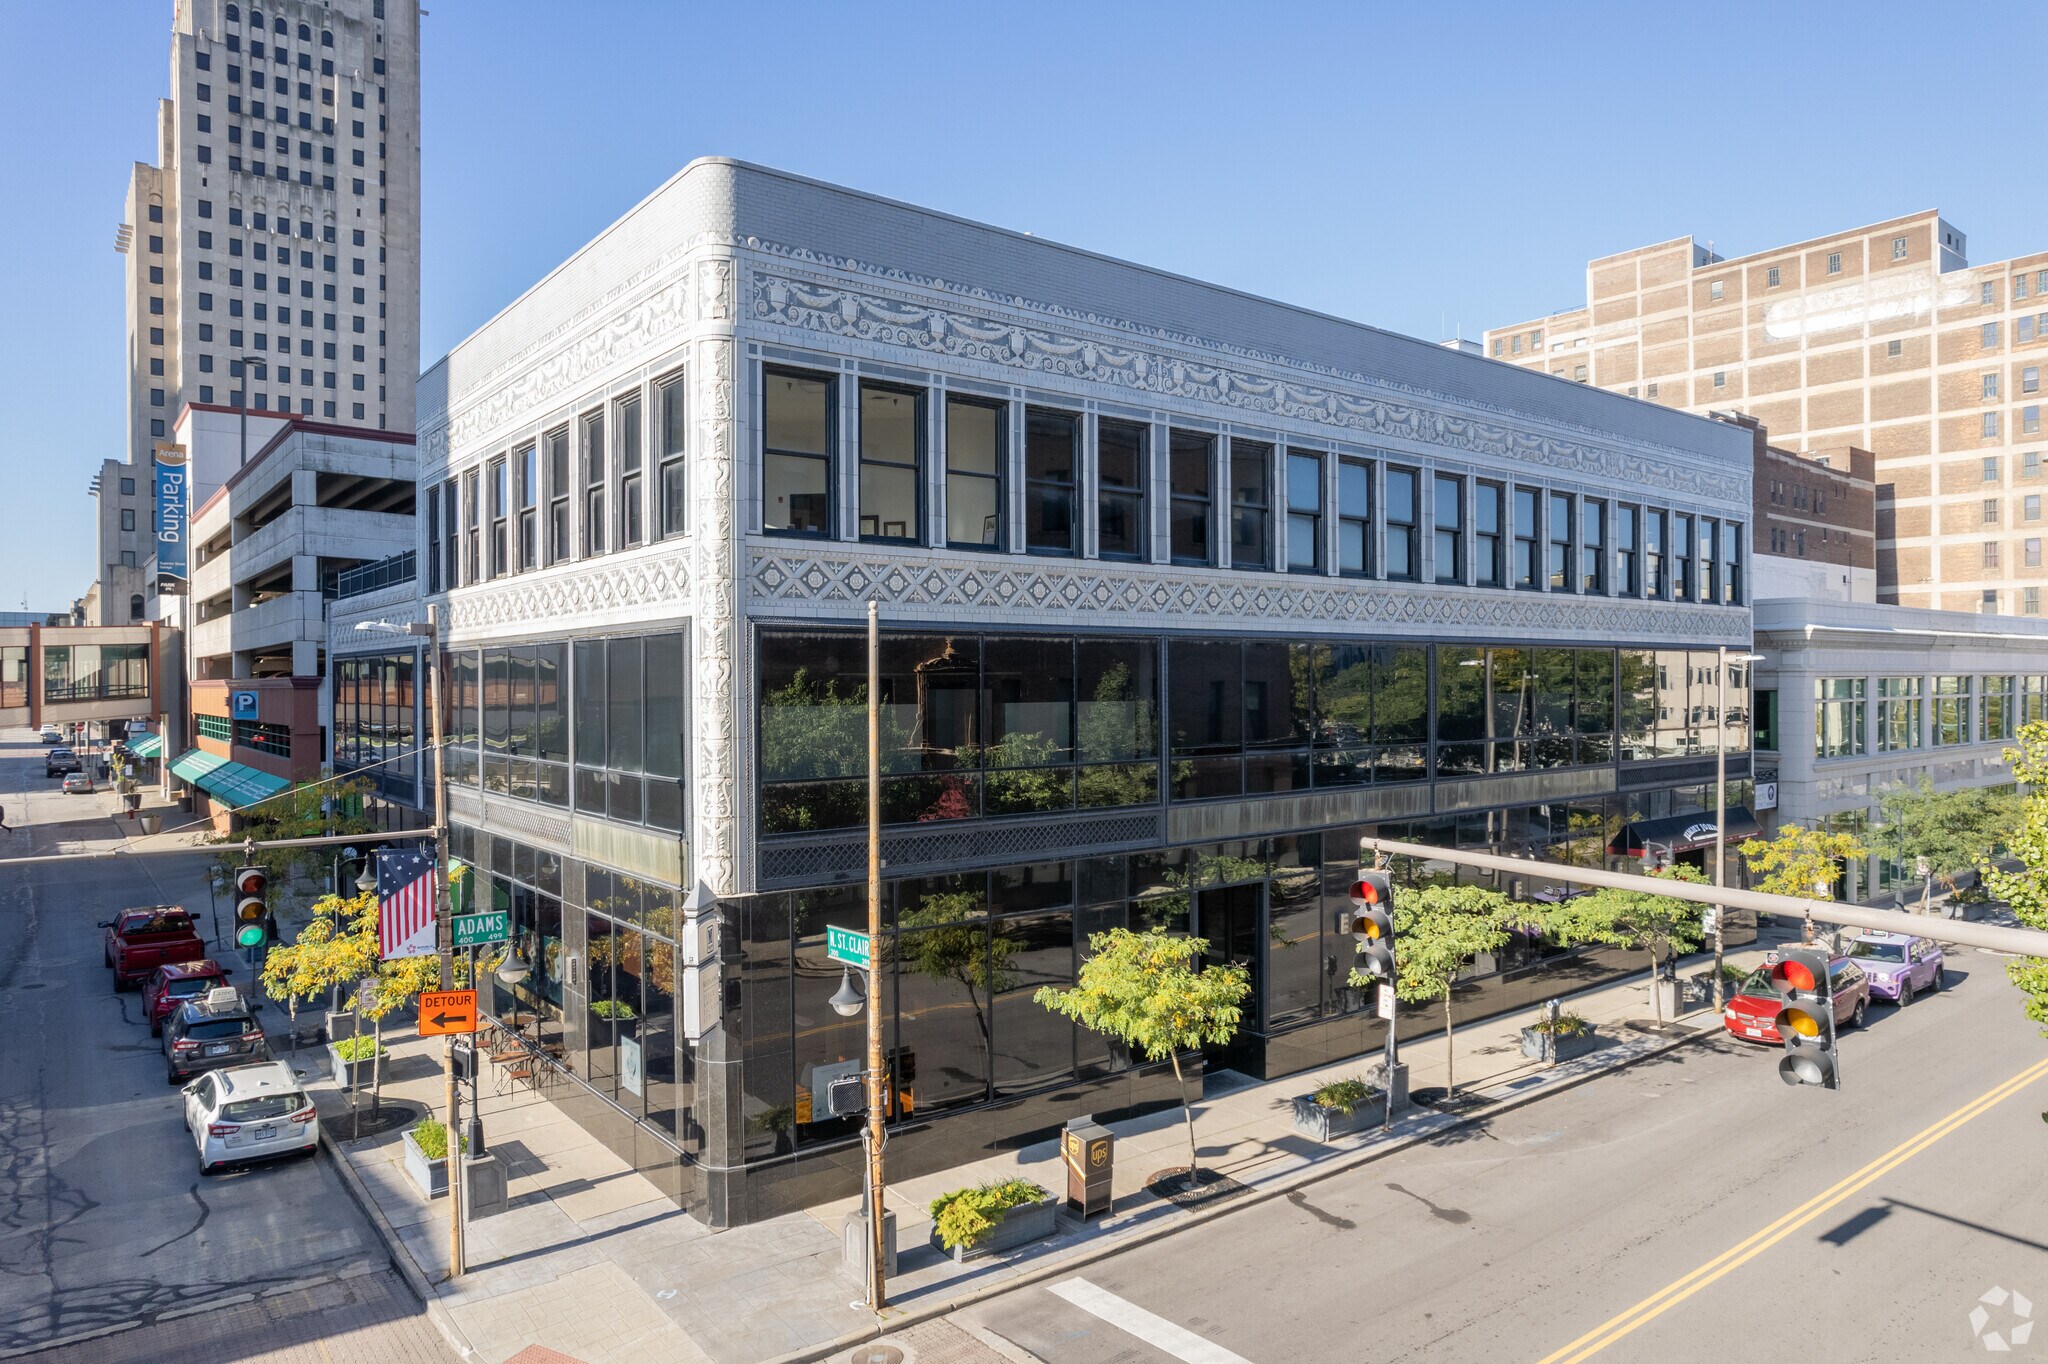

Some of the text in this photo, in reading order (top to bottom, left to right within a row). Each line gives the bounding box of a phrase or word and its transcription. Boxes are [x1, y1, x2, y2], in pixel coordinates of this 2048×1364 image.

[159, 449, 184, 459] Arena
[158, 473, 184, 543] Parking
[239, 695, 253, 711] P
[1683, 824, 1701, 841] JIMMY
[1699, 823, 1719, 832] JOHN
[458, 915, 503, 936] ADAMS
[458, 932, 503, 944] 400 499
[830, 930, 870, 957] N. ST. CLAIR
[425, 995, 472, 1008] DETOUR
[1091, 1148, 1108, 1164] ups
